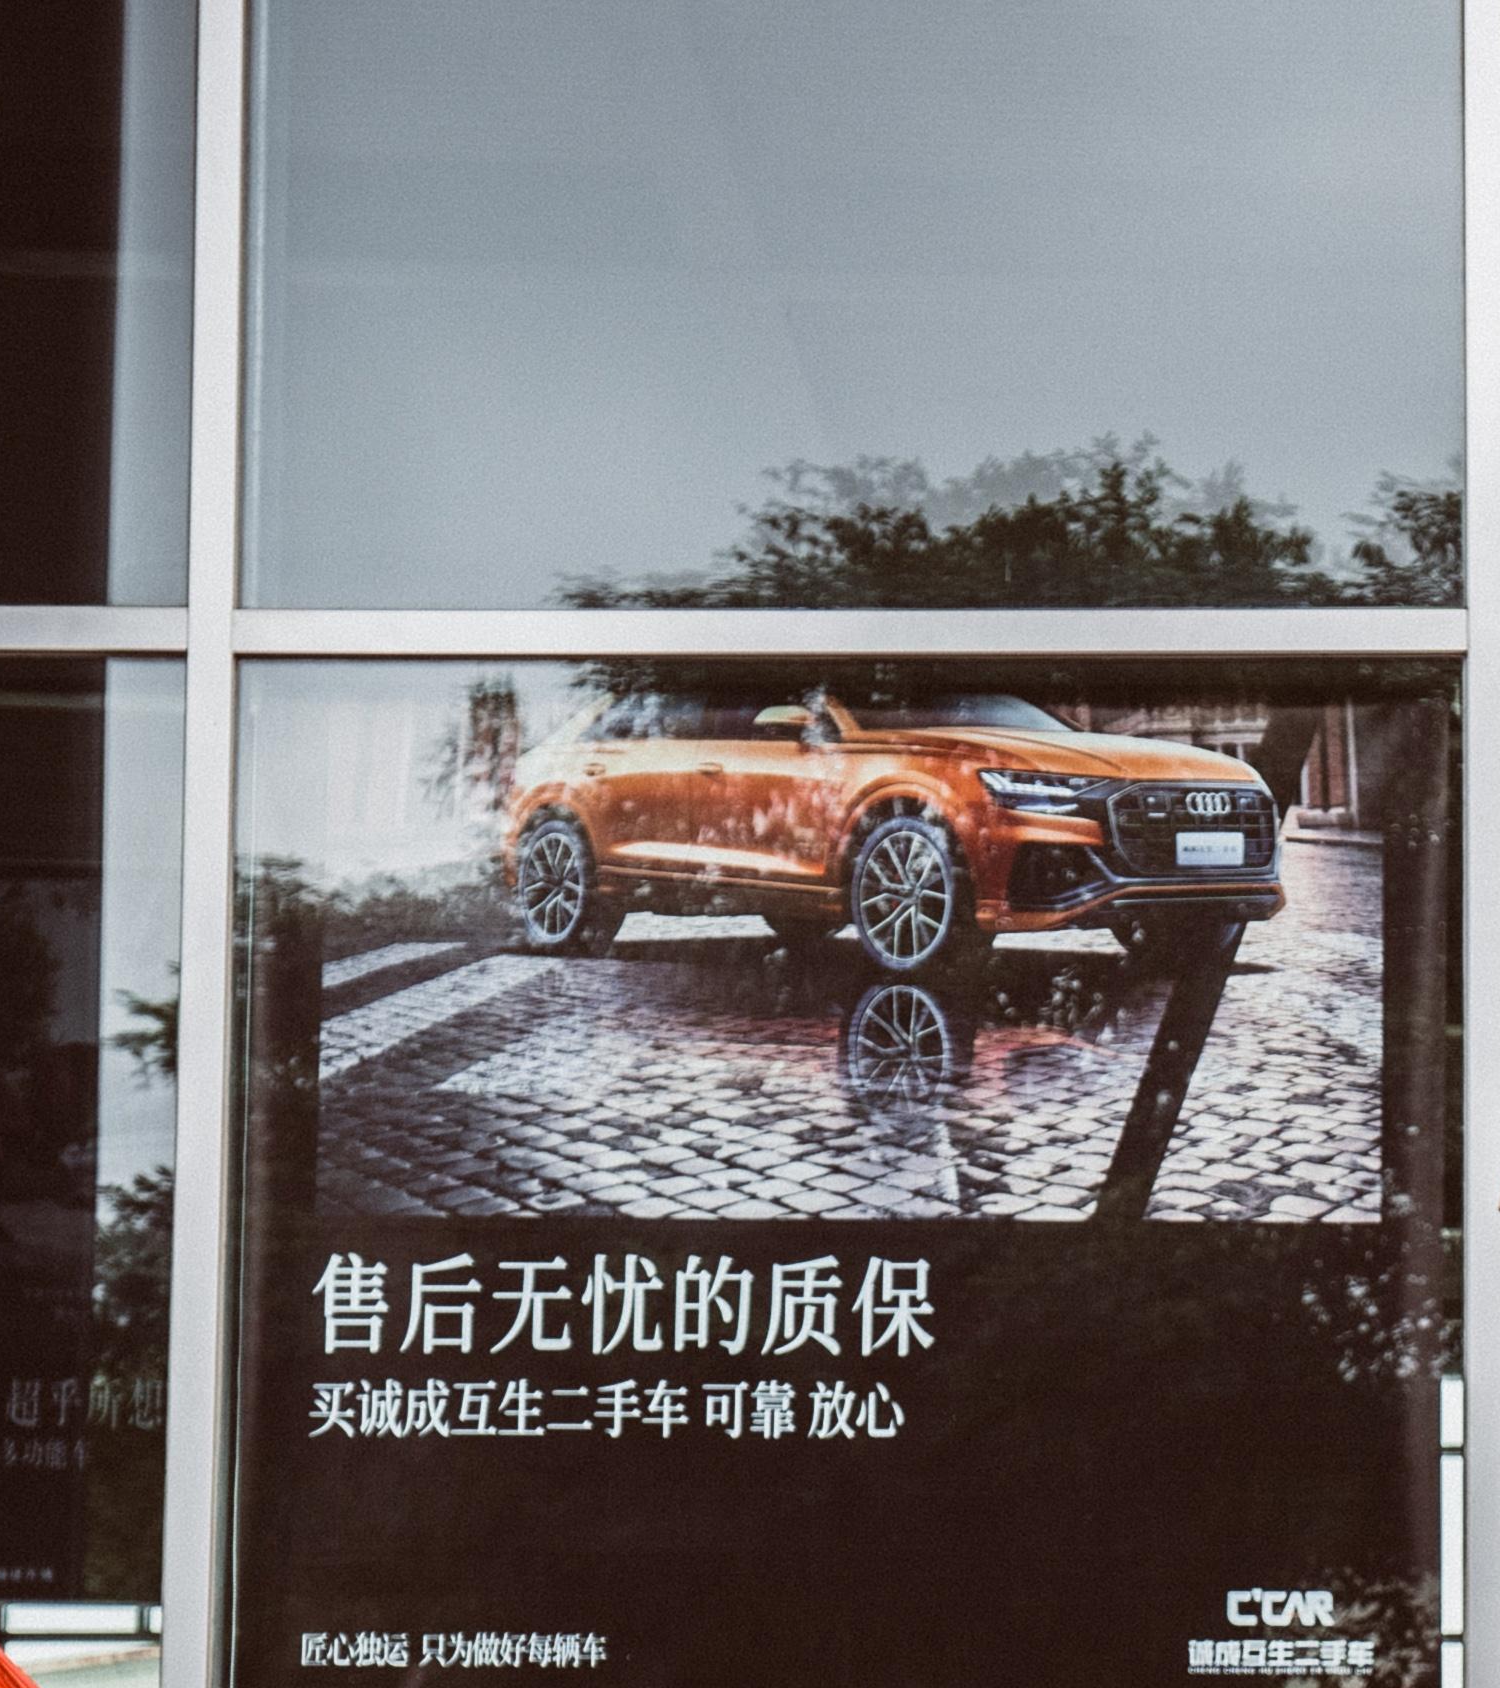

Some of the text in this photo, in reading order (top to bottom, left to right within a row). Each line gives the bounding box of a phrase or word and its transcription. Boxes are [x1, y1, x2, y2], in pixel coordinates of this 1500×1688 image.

[311, 1251, 937, 1357] 售后无忧的质保
[308, 1378, 905, 1440] 买诚成互生二手车 可靠 放心
[300, 1630, 608, 1669] 匠心独运 只为做好每辆车
